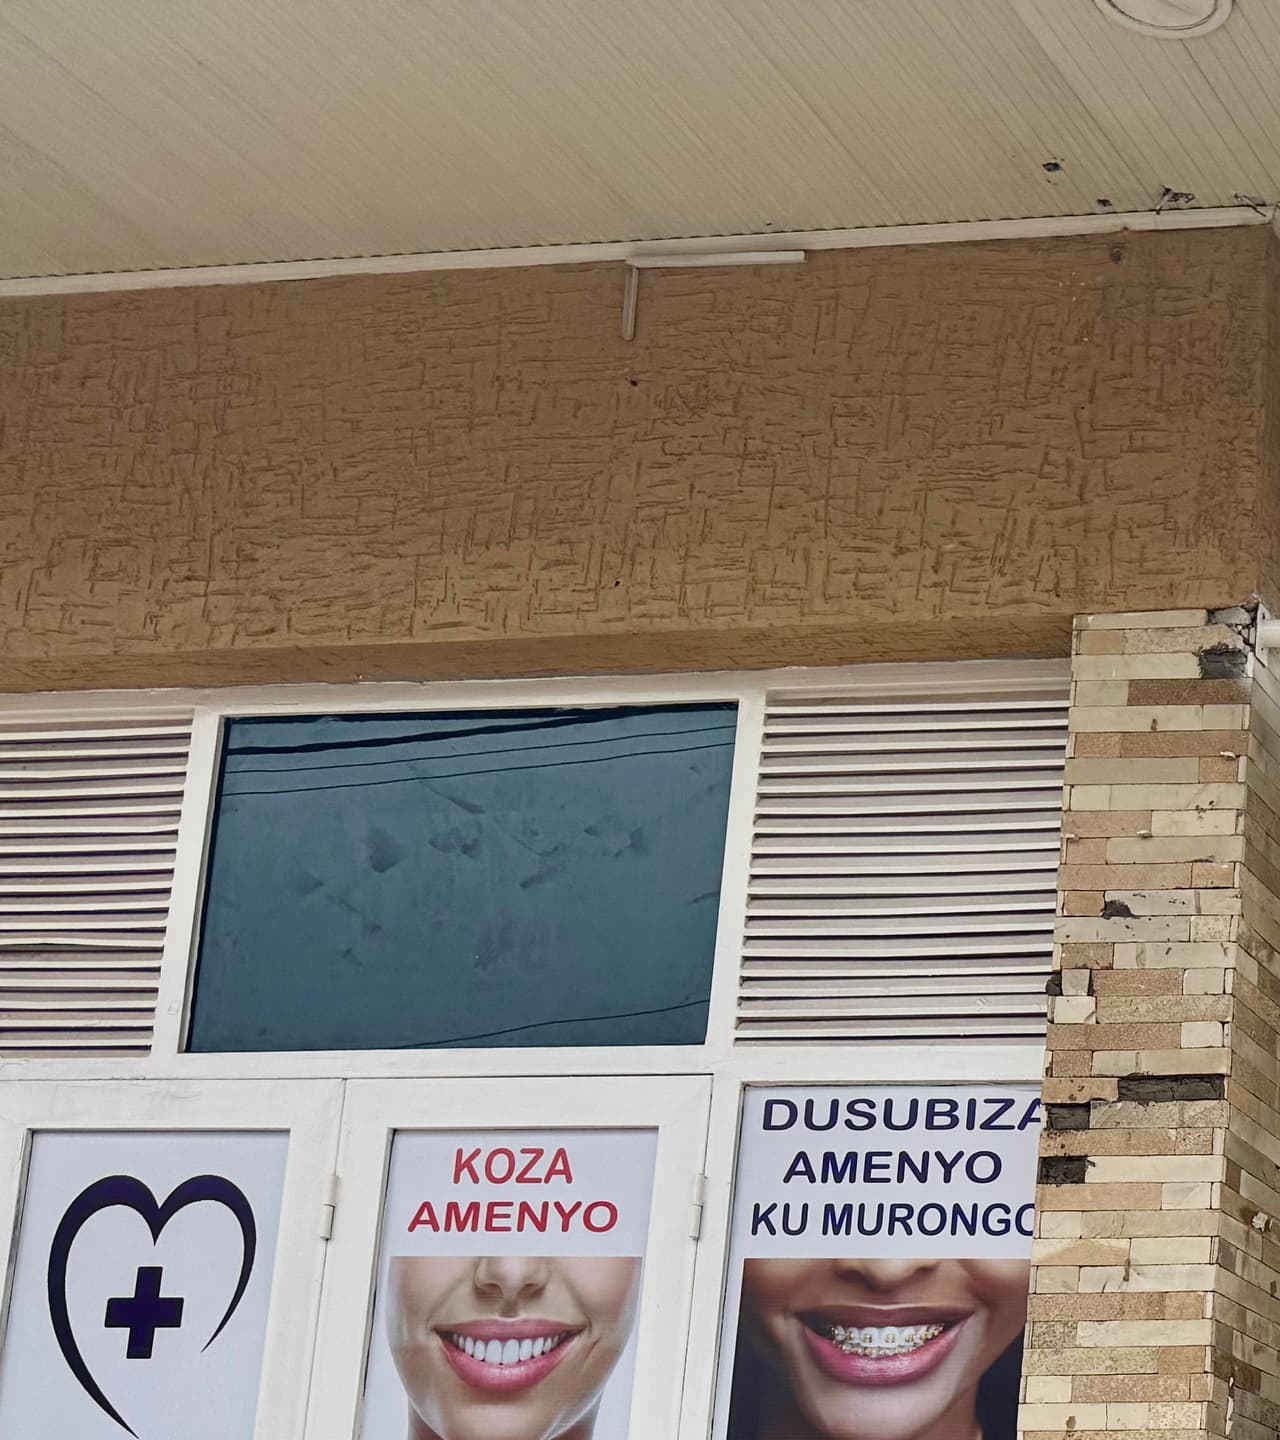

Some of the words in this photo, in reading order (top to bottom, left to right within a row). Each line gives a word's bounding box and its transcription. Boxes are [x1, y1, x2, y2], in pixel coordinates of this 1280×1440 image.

[762, 1098, 1041, 1131] DUSUBIZA
[452, 1147, 574, 1184] KOZA
[783, 1150, 1002, 1184] AMENYO
[407, 1200, 618, 1233] AMENYO
[751, 1202, 809, 1236] KU
